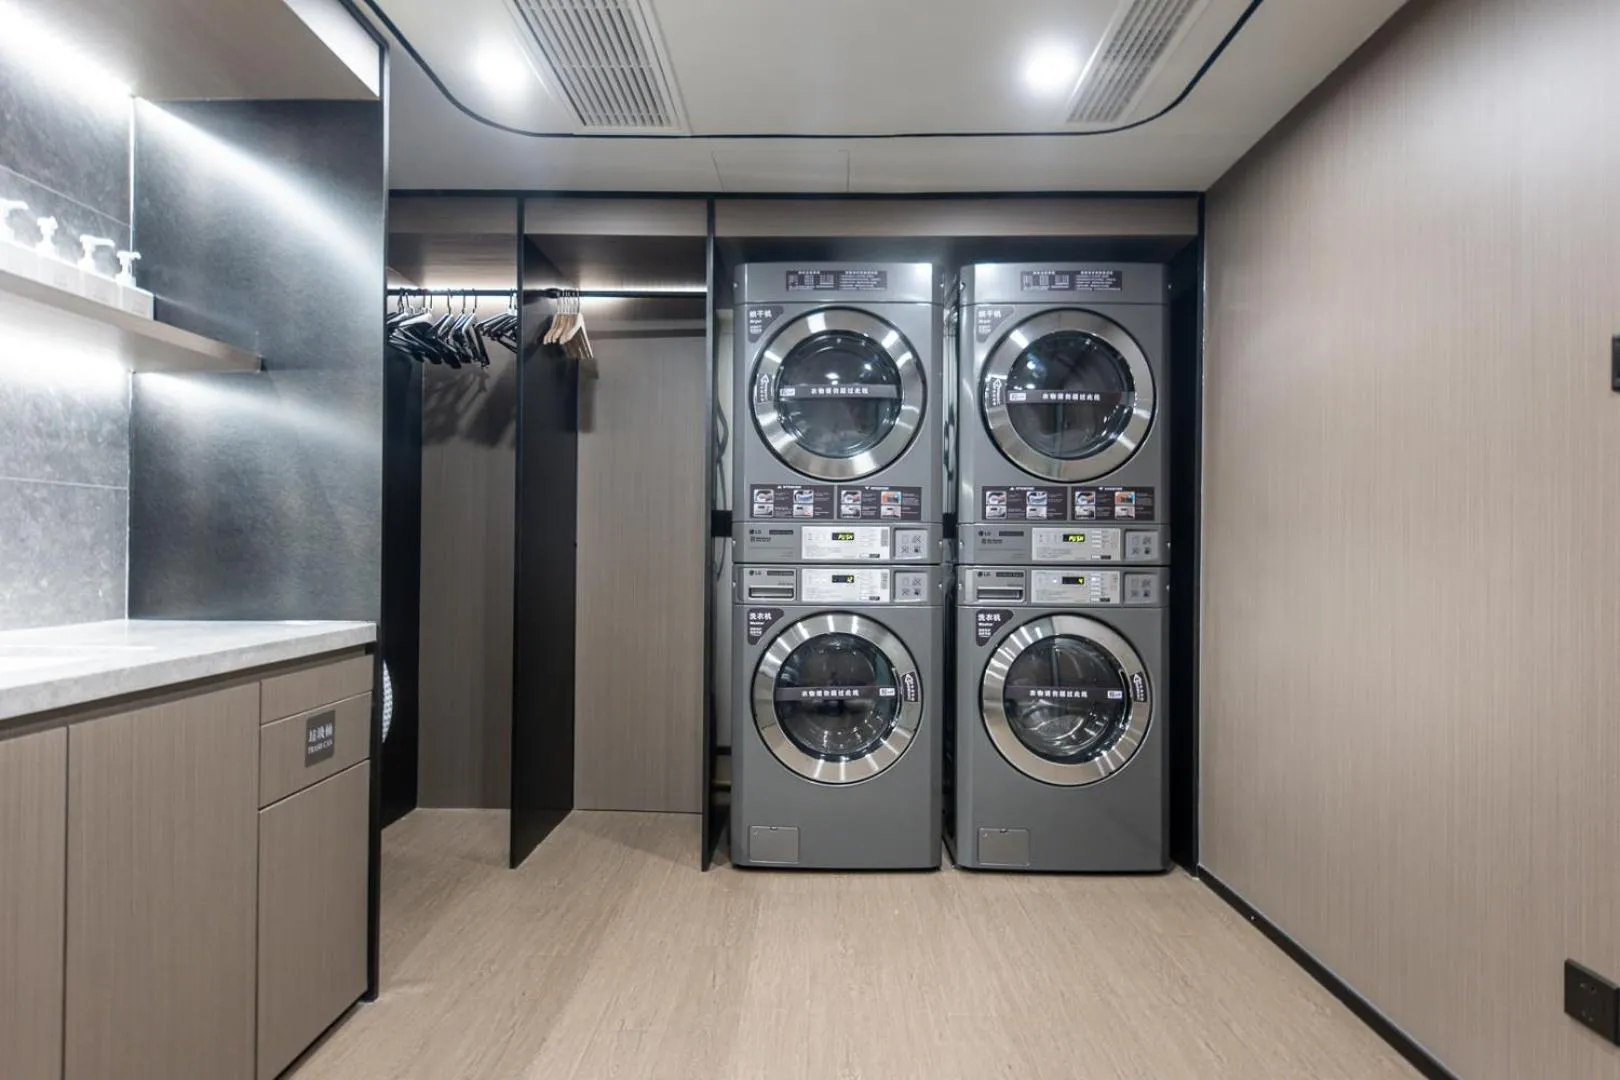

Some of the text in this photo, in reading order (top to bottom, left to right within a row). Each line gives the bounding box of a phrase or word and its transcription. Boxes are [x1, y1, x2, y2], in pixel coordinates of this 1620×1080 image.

[749, 310, 772, 318] 烘干机
[749, 612, 772, 620] 洗衣机
[978, 613, 1001, 621] 洗衣机
